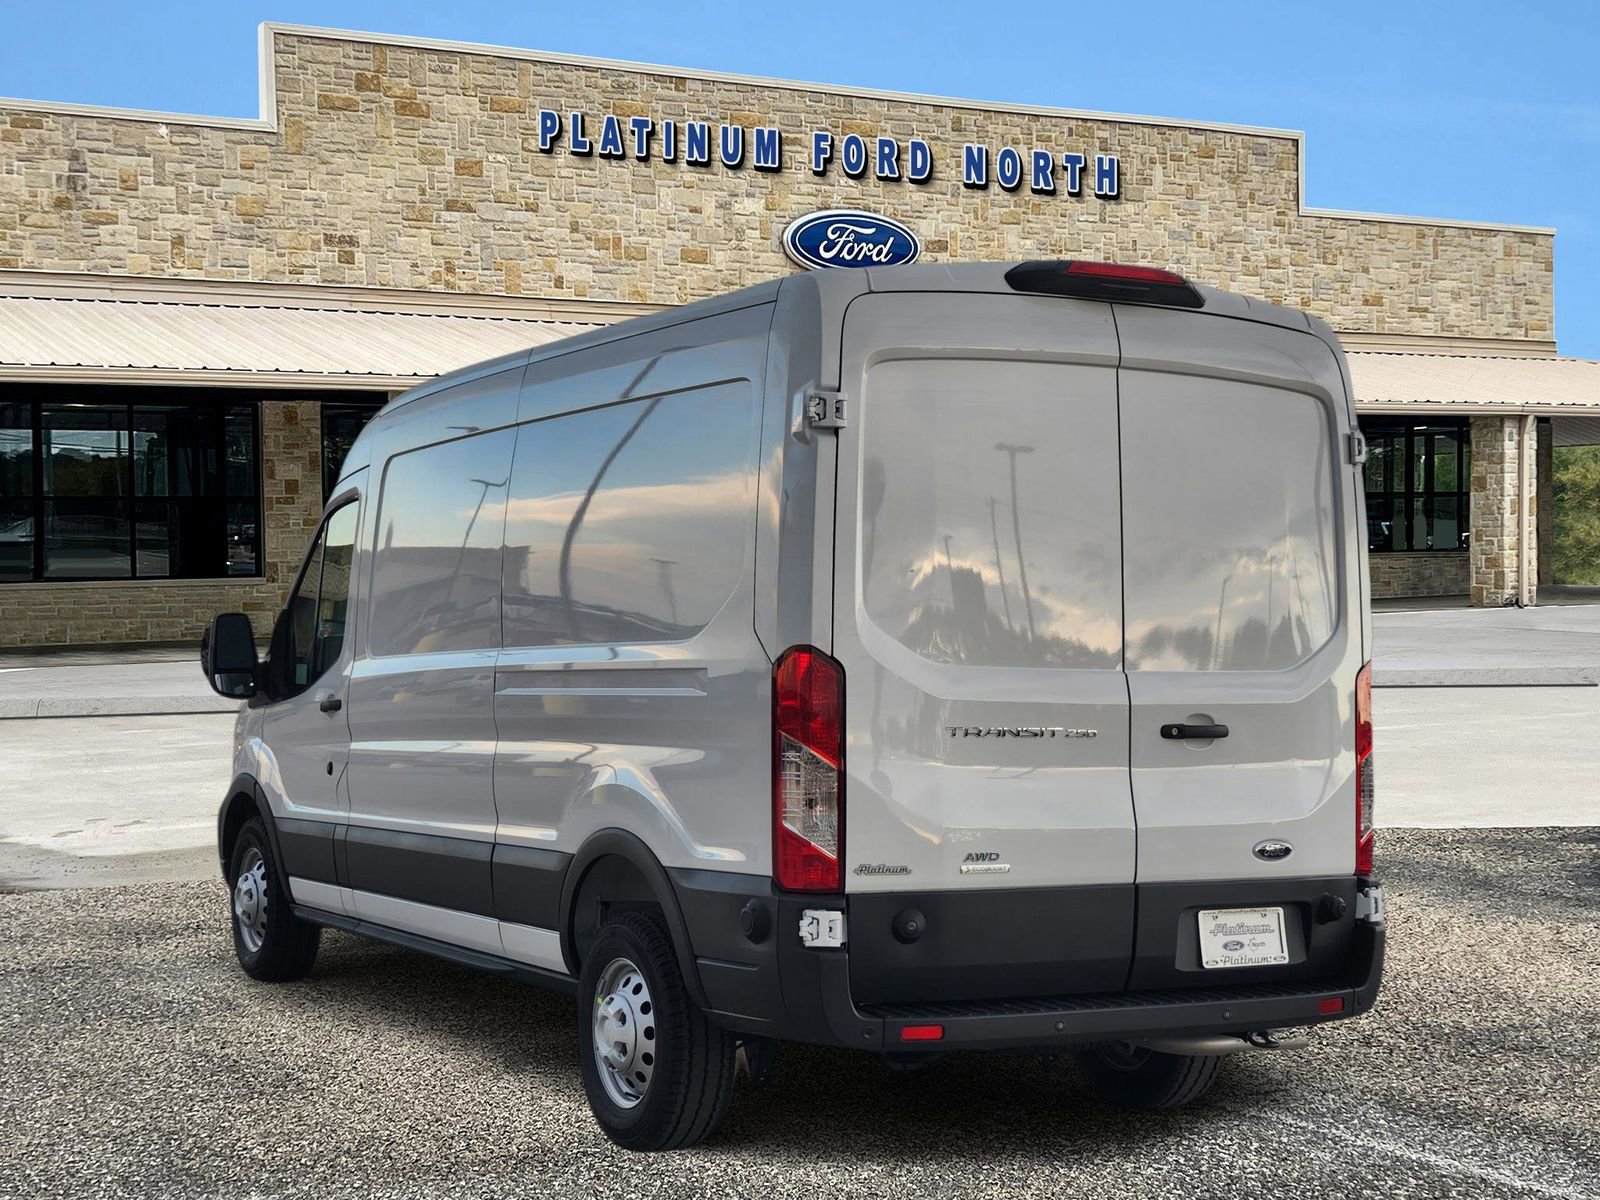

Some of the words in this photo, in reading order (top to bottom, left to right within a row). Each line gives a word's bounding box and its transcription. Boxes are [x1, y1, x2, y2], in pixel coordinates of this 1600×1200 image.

[538, 109, 782, 171] PLATINUM
[813, 131, 932, 183] FORD
[962, 144, 1121, 199] NORTH
[819, 223, 895, 263] Ford
[945, 726, 1063, 738] TRANSIT
[1065, 728, 1098, 738] 250
[963, 852, 1000, 863] AWD
[853, 863, 912, 876] Platinum
[1209, 922, 1274, 936] Platinum
[1223, 955, 1269, 965] Platinum
